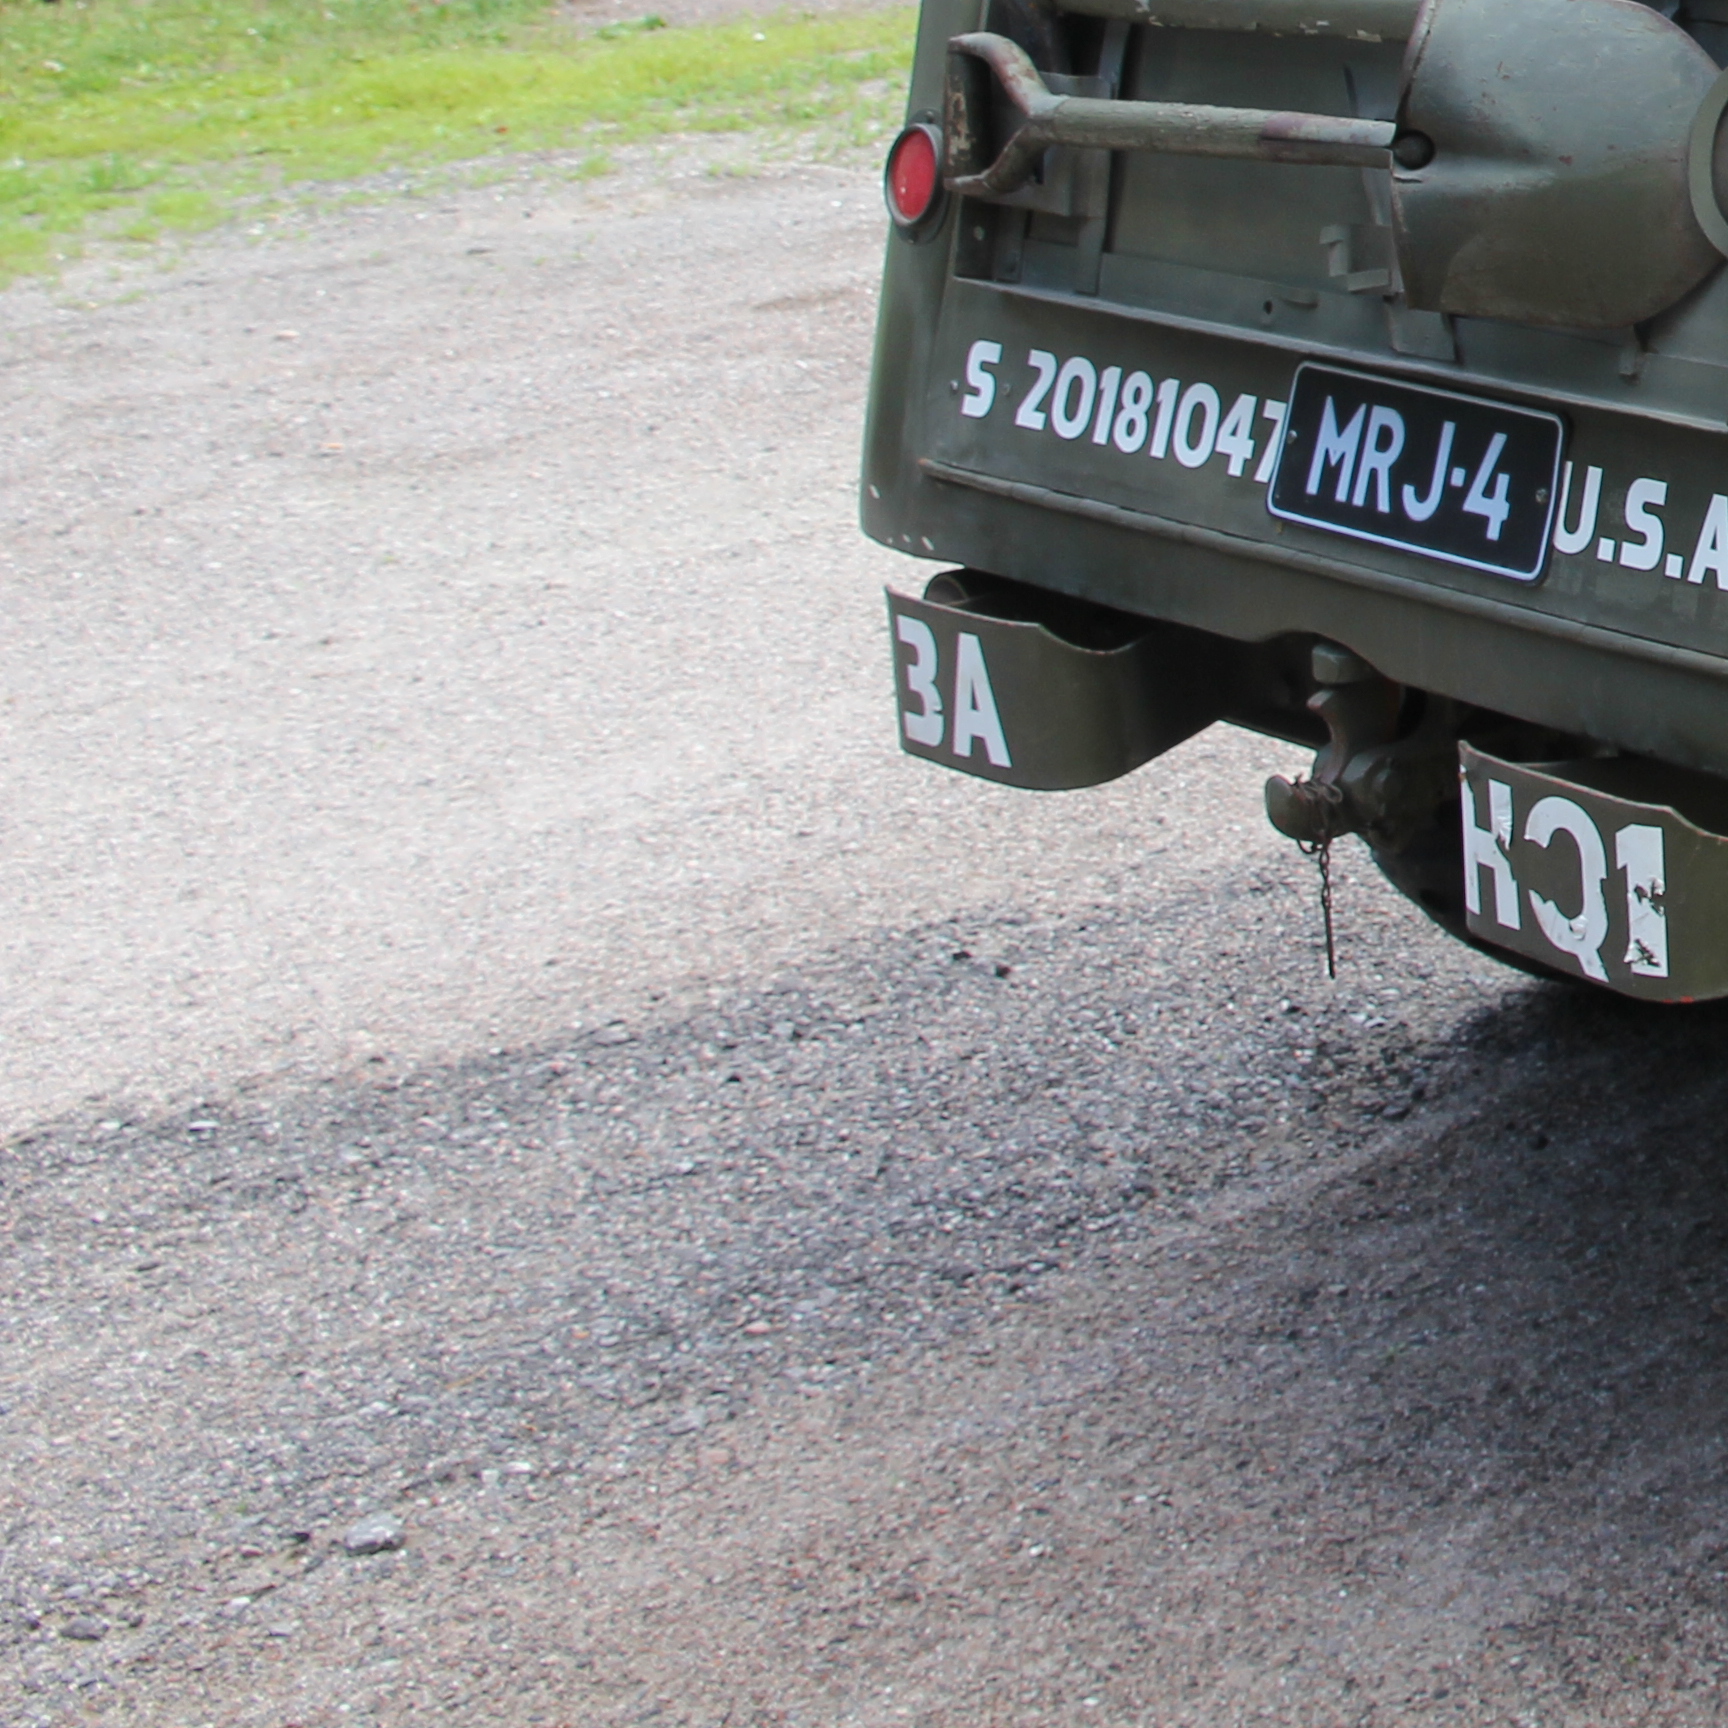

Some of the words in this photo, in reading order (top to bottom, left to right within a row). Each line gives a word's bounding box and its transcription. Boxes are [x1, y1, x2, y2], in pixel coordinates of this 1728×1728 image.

[961, 340, 1001, 419] S
[1015, 349, 1286, 484] 20181047
[1304, 394, 1510, 542] MRJ-4
[897, 614, 1012, 770] 3A
